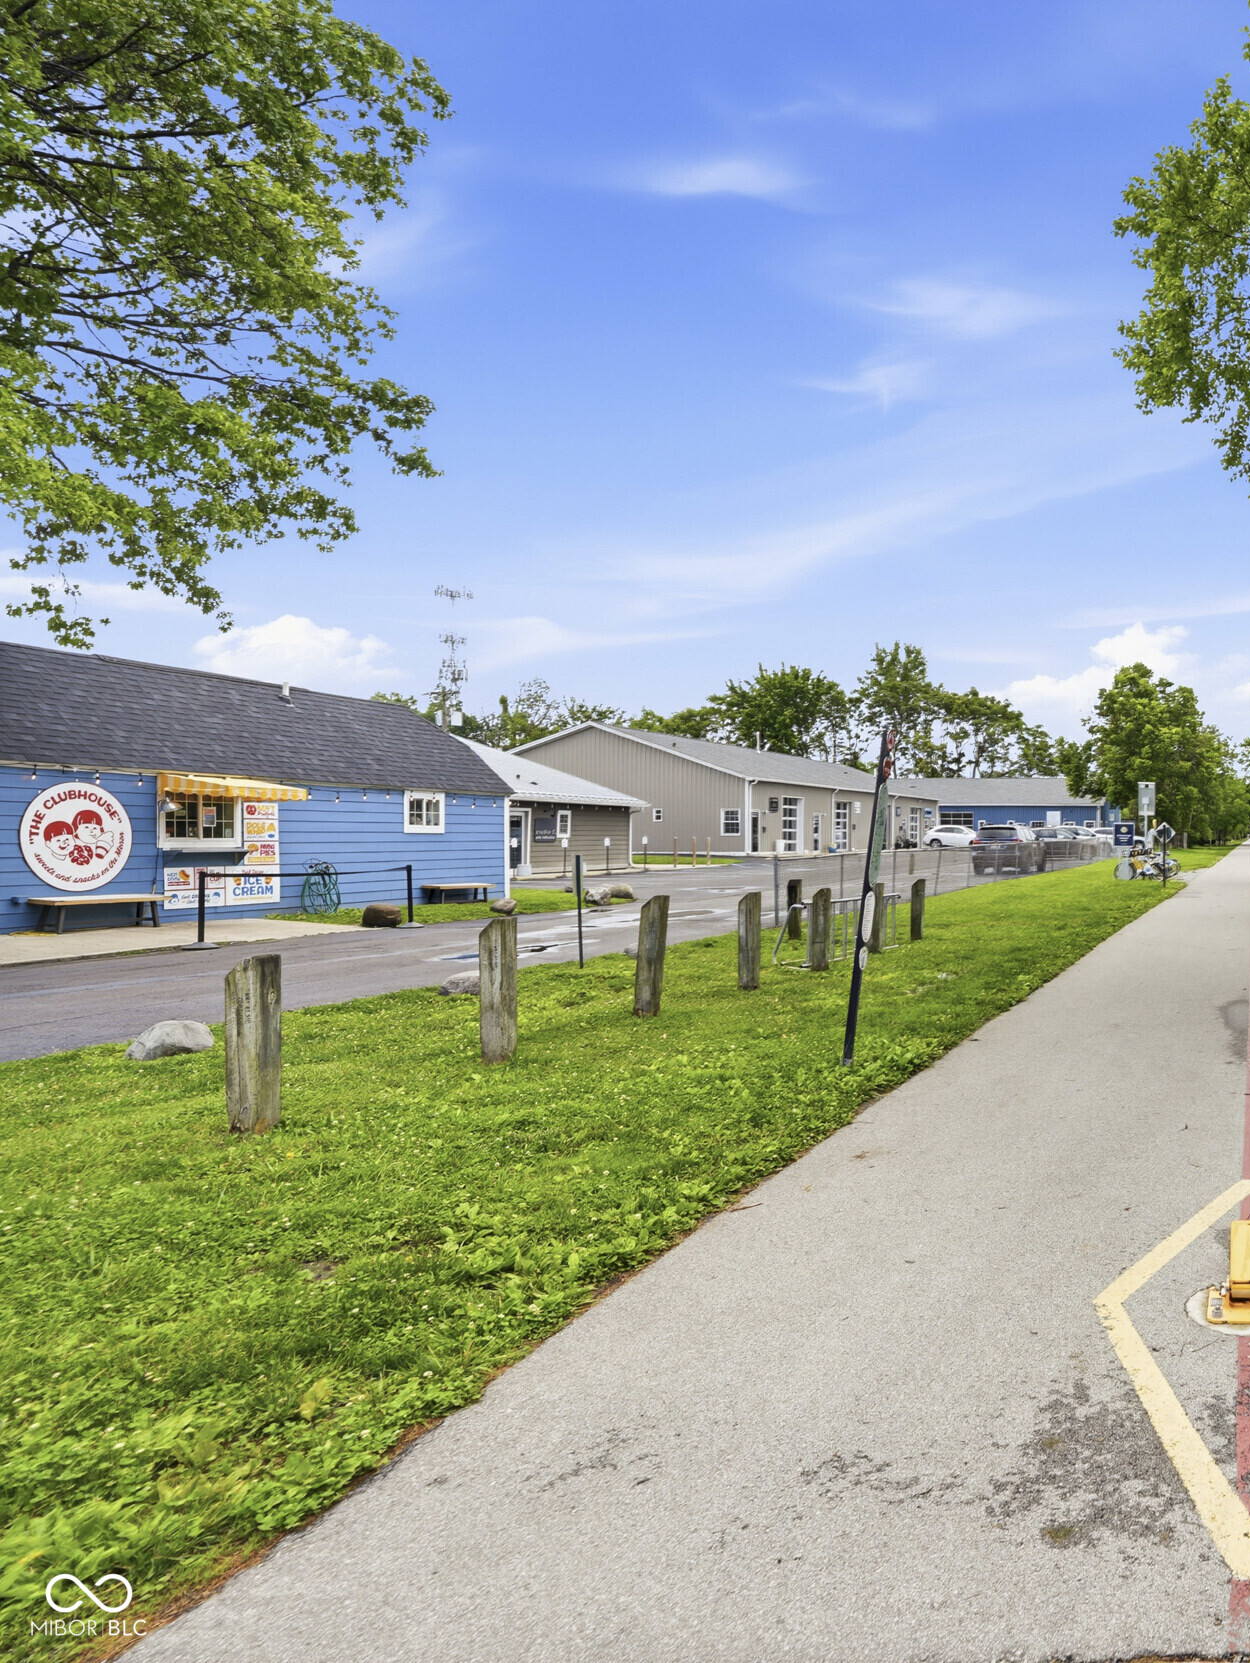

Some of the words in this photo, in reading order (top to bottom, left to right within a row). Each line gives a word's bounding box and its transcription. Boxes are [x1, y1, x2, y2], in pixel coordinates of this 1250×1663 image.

[28, 809, 46, 845] "THE
[43, 789, 122, 824] CLUBHOUSE"
[55, 873, 72, 882] and
[72, 873, 100, 883] snacks
[243, 876, 262, 885] ICE
[232, 885, 273, 896] CREAM
